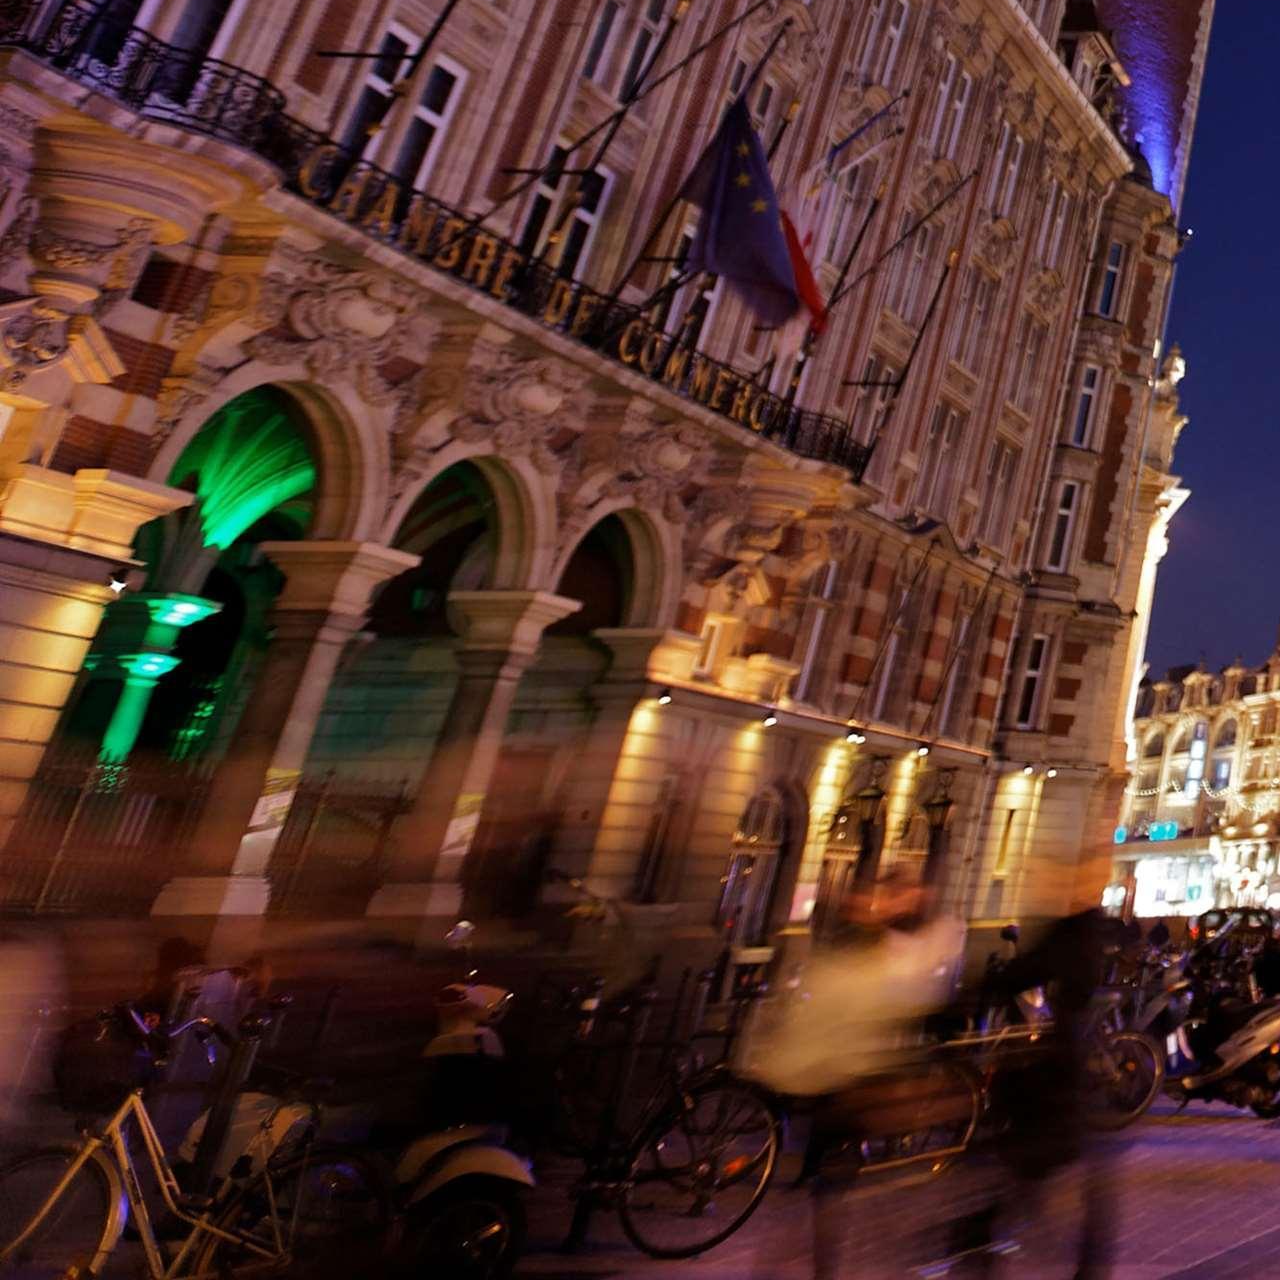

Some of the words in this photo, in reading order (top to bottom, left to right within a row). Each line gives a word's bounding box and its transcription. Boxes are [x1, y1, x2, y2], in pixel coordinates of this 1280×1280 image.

[299, 144, 525, 301] CHAMBRE
[544, 277, 605, 338] DE
[618, 318, 788, 446] COMMERC
